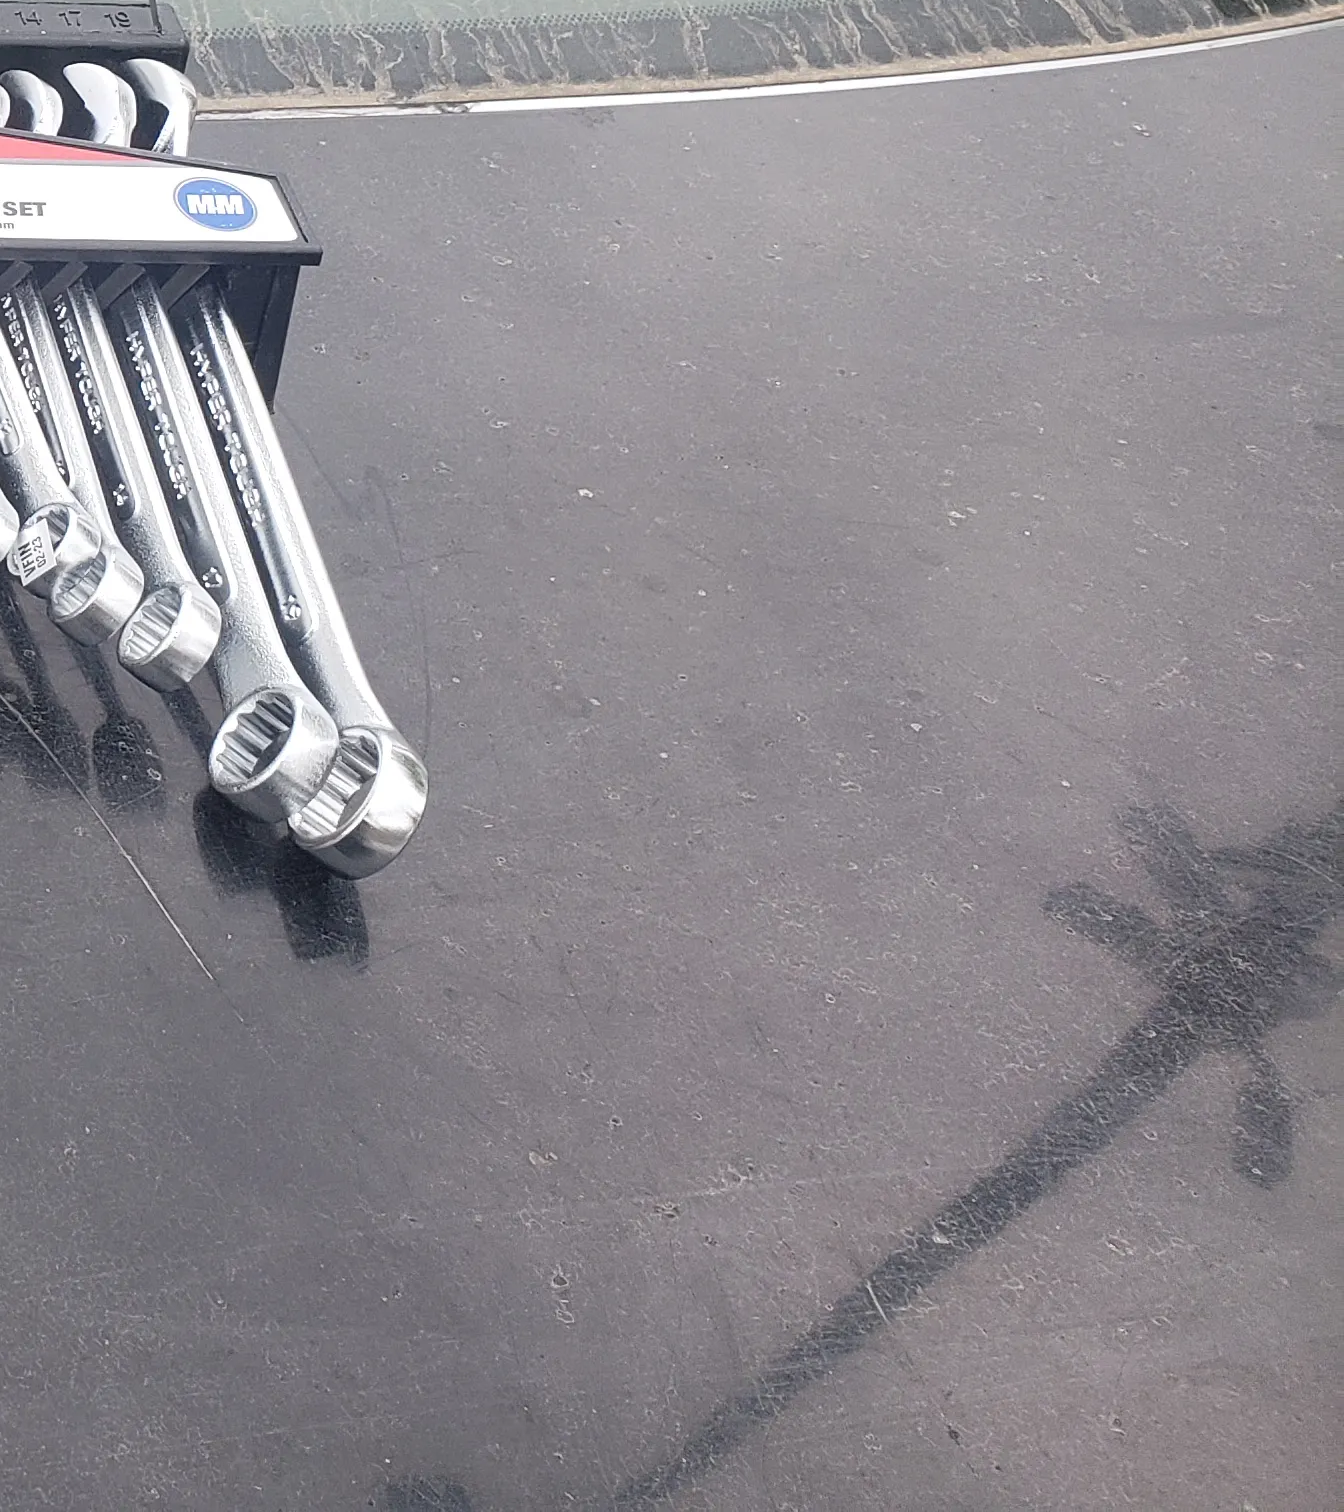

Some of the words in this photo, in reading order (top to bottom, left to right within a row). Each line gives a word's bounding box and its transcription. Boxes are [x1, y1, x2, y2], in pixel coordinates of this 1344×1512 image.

[14, 10, 43, 27] 14
[58, 11, 81, 27] 17
[104, 11, 131, 28] 19
[2, 201, 47, 217] SET
[186, 194, 245, 215] MM
[17, 346, 42, 413] TOUGH
[75, 361, 104, 435] TOUGH
[126, 330, 162, 412] HYPER
[154, 412, 193, 501] TOUGH
[189, 342, 233, 431] HYPER
[223, 431, 266, 527] TOUGH
[17, 541, 37, 579] VFIN
